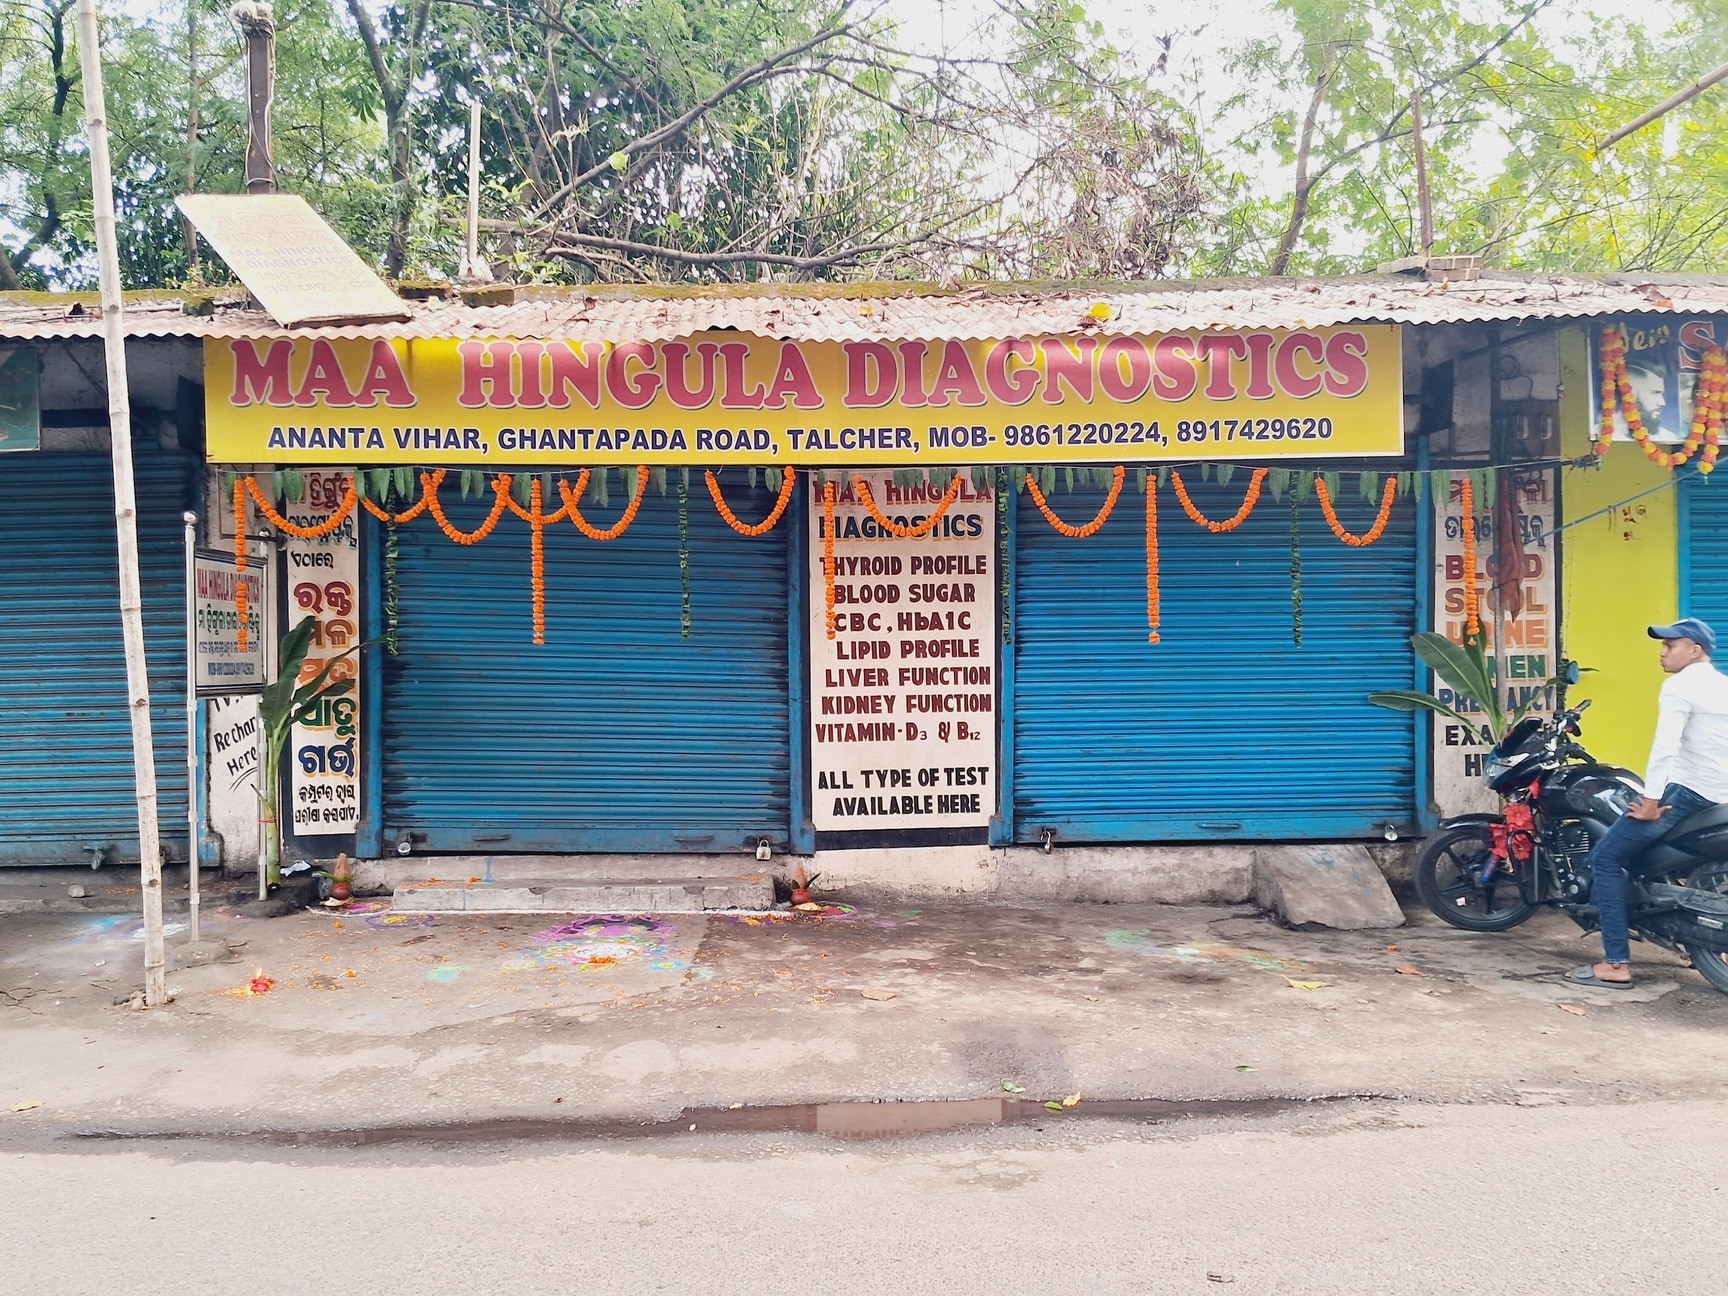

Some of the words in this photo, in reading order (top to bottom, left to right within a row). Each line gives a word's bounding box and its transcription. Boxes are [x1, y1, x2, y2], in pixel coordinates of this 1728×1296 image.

[230, 248, 266, 258] MAA
[274, 246, 342, 256] HINGULA
[245, 257, 353, 268] DIAGNOSTICS
[229, 339, 417, 407] MAA
[457, 339, 824, 410] HINGULA
[842, 331, 1368, 408] DIAGNOSTICS
[267, 426, 386, 450] ANANTA
[394, 427, 490, 454] VIHAR,
[497, 427, 687, 452] GHANTAPADA
[696, 428, 780, 455] ROAD,
[786, 426, 921, 453] TALCHER,
[928, 425, 996, 448] MOB-
[1004, 421, 1169, 448] 9861220224,
[1176, 417, 1333, 442] 8917429620
[910, 555, 987, 575] PROFILE
[834, 584, 900, 604] BLOOD
[909, 583, 976, 603] SUGAR
[836, 641, 891, 660] LIPID
[900, 639, 980, 659] PROFILE
[825, 668, 889, 687] LIVER
[899, 666, 990, 686] FUNCTION
[821, 695, 896, 714] KIDNEY
[906, 693, 991, 713] FUNCTION
[227, 746, 257, 776] Here
[818, 771, 853, 790] ALL
[861, 769, 910, 788] TYPE
[918, 768, 940, 787] OF
[944, 766, 989, 786] TEST
[832, 795, 933, 816] AVAILABLE
[938, 793, 980, 814] HERE
